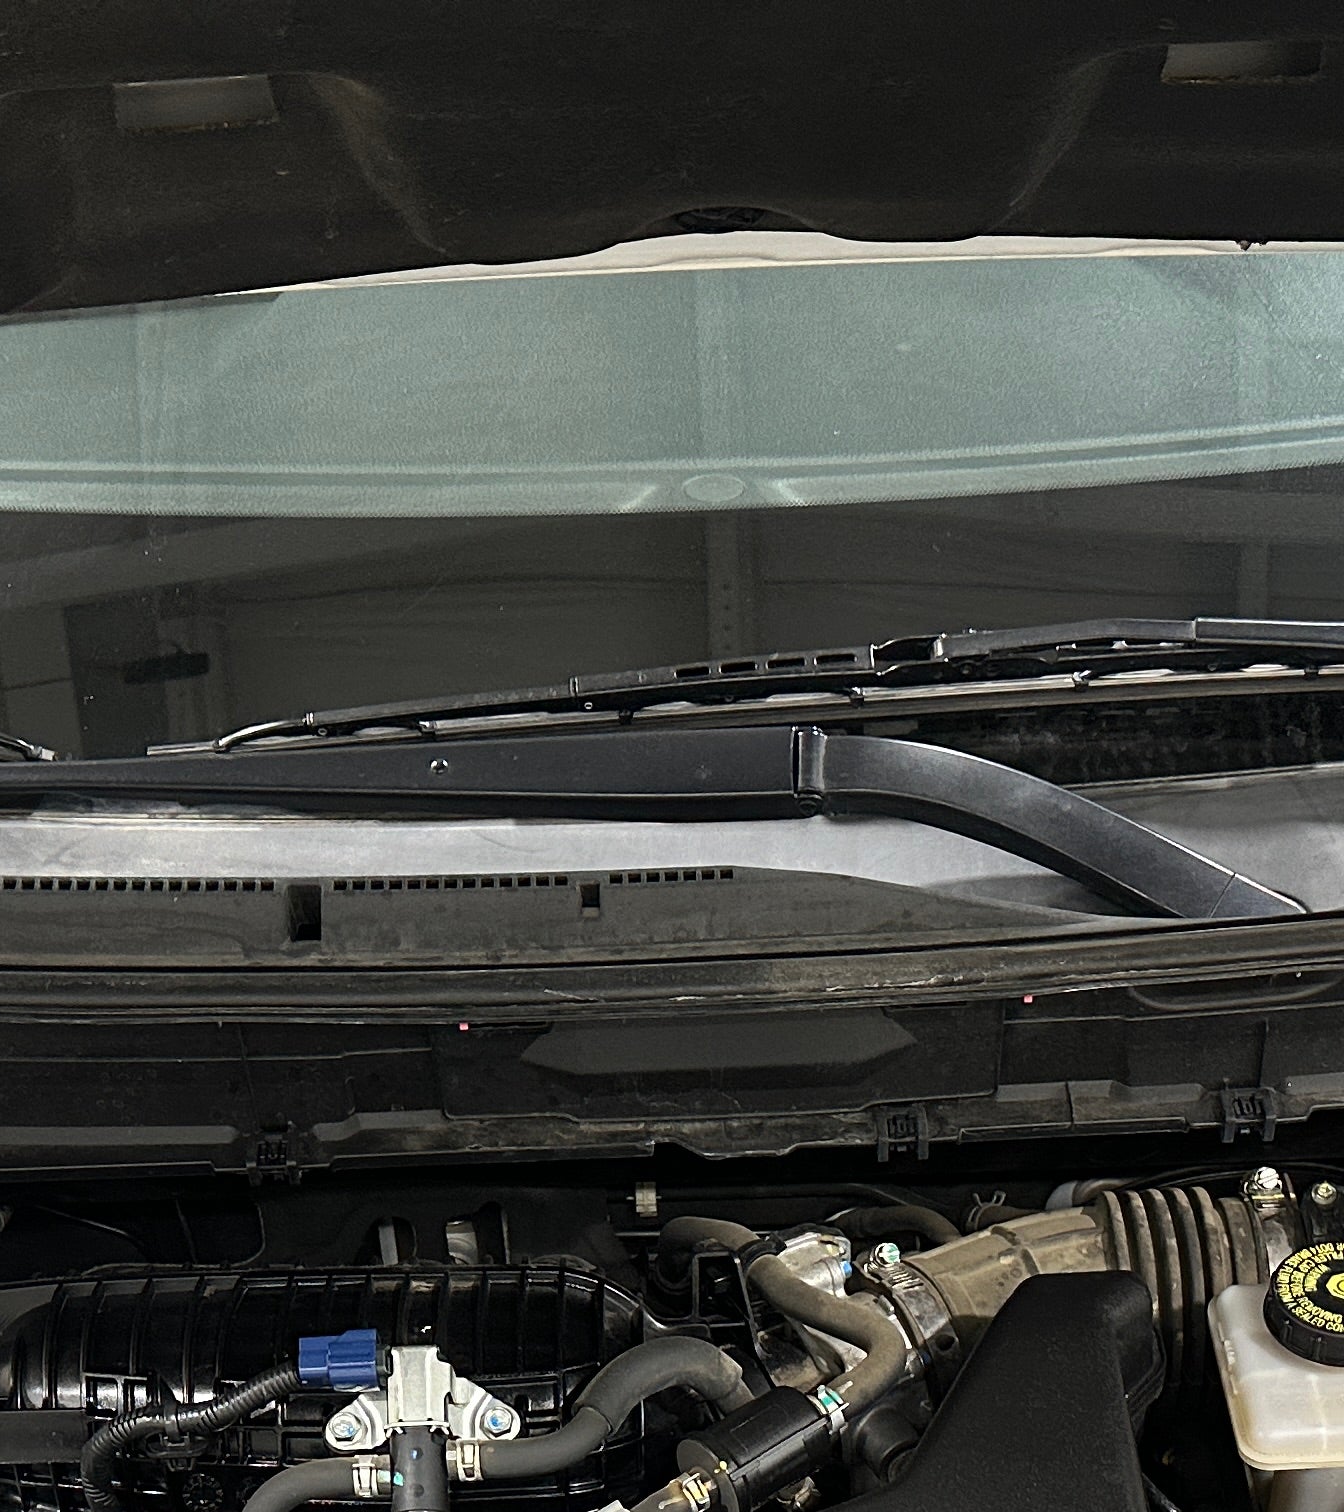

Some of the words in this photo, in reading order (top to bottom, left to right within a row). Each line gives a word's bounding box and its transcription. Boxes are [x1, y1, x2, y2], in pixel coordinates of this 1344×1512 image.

[1311, 1251, 1344, 1263] FILLER
[1292, 1306, 1324, 1327] SEALED
[1298, 1297, 1342, 1323] REMOVING
